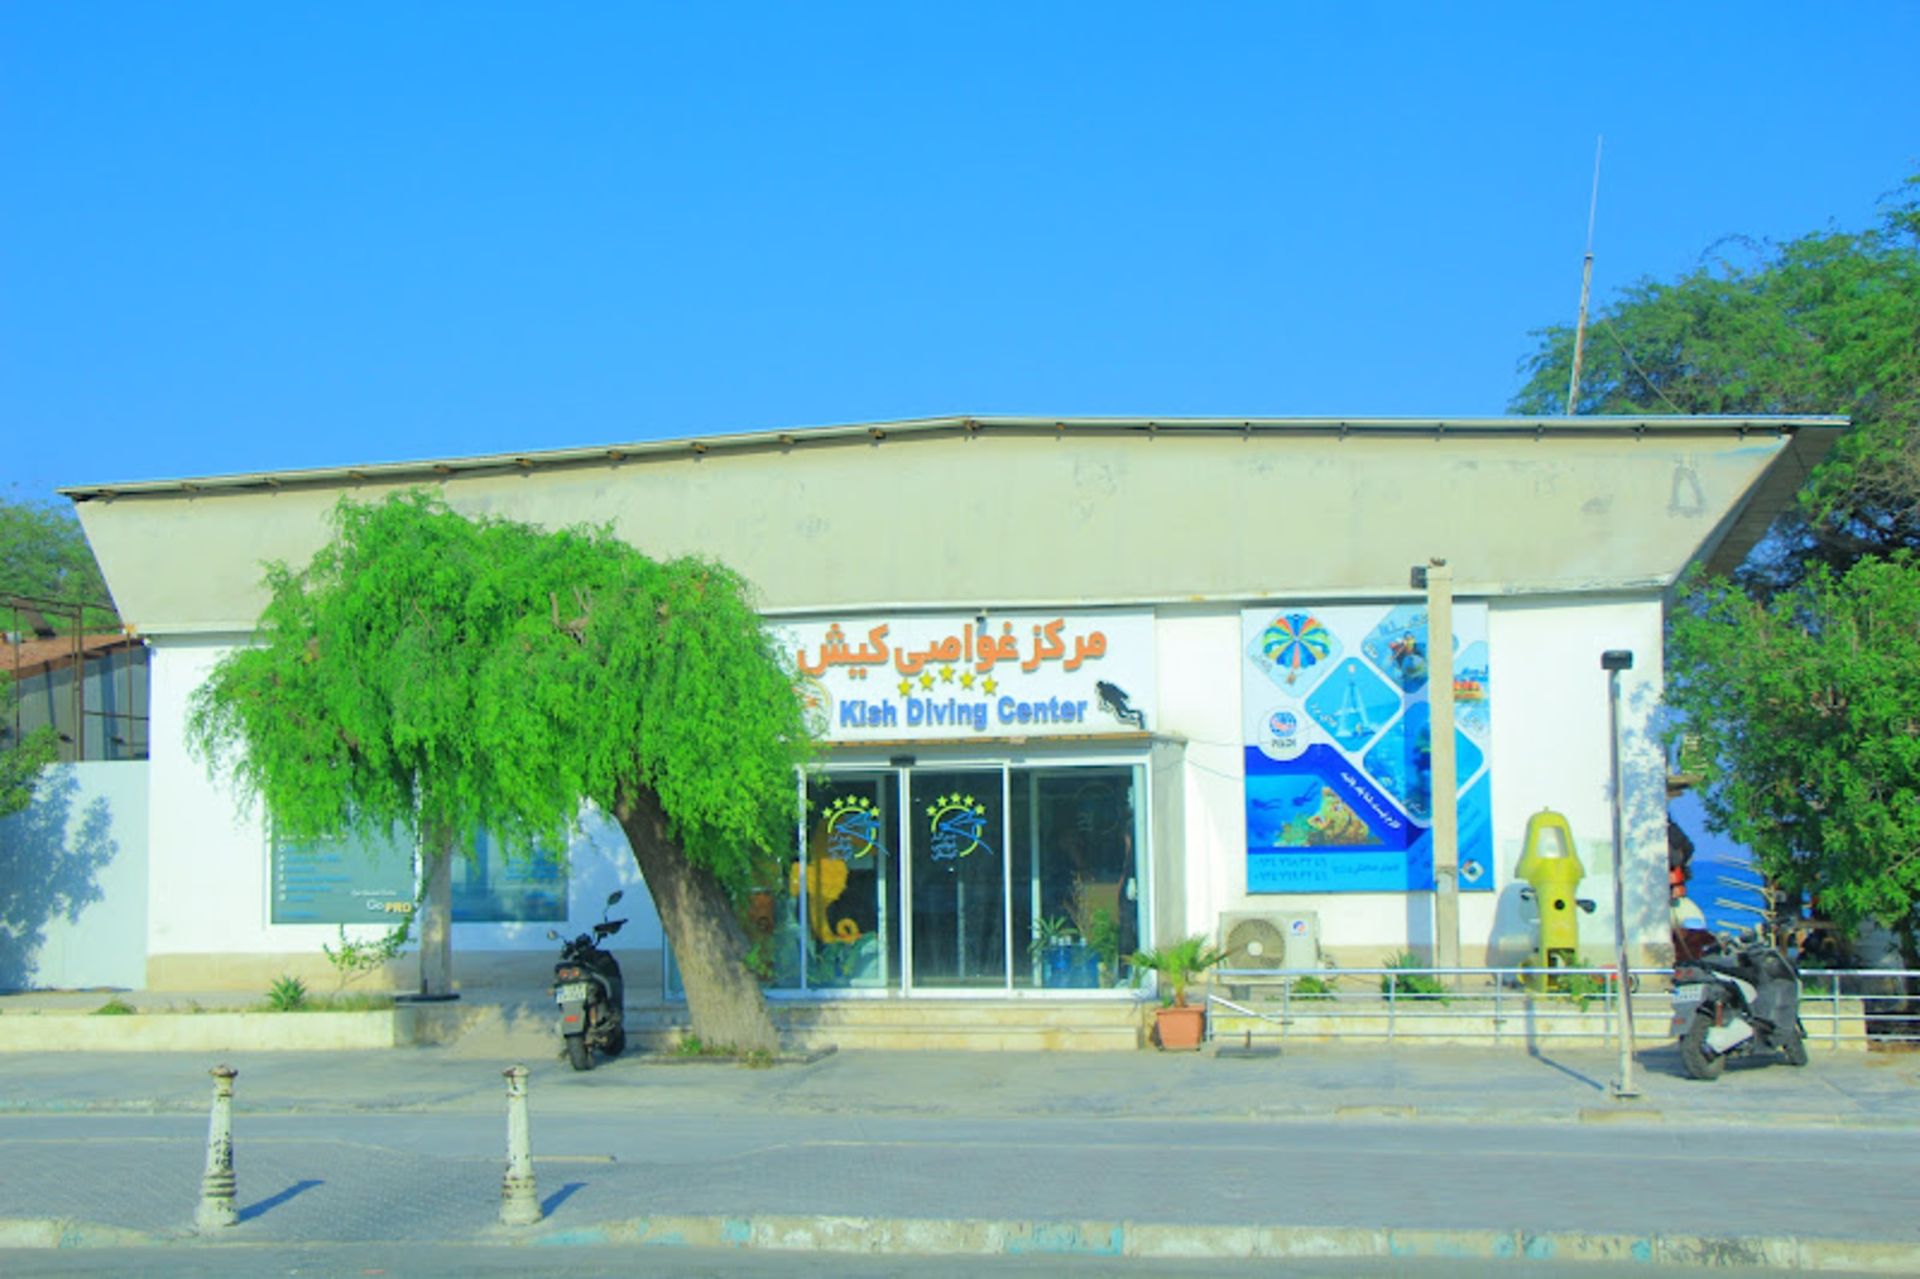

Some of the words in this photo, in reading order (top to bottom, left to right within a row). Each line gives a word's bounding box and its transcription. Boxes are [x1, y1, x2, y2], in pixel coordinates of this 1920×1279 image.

[797, 622, 890, 678] کیش
[894, 621, 1019, 675] غواصی
[1020, 617, 1108, 672] مرکز
[840, 699, 897, 727] Kish
[906, 697, 988, 730] Diving
[997, 695, 1089, 724] Center
